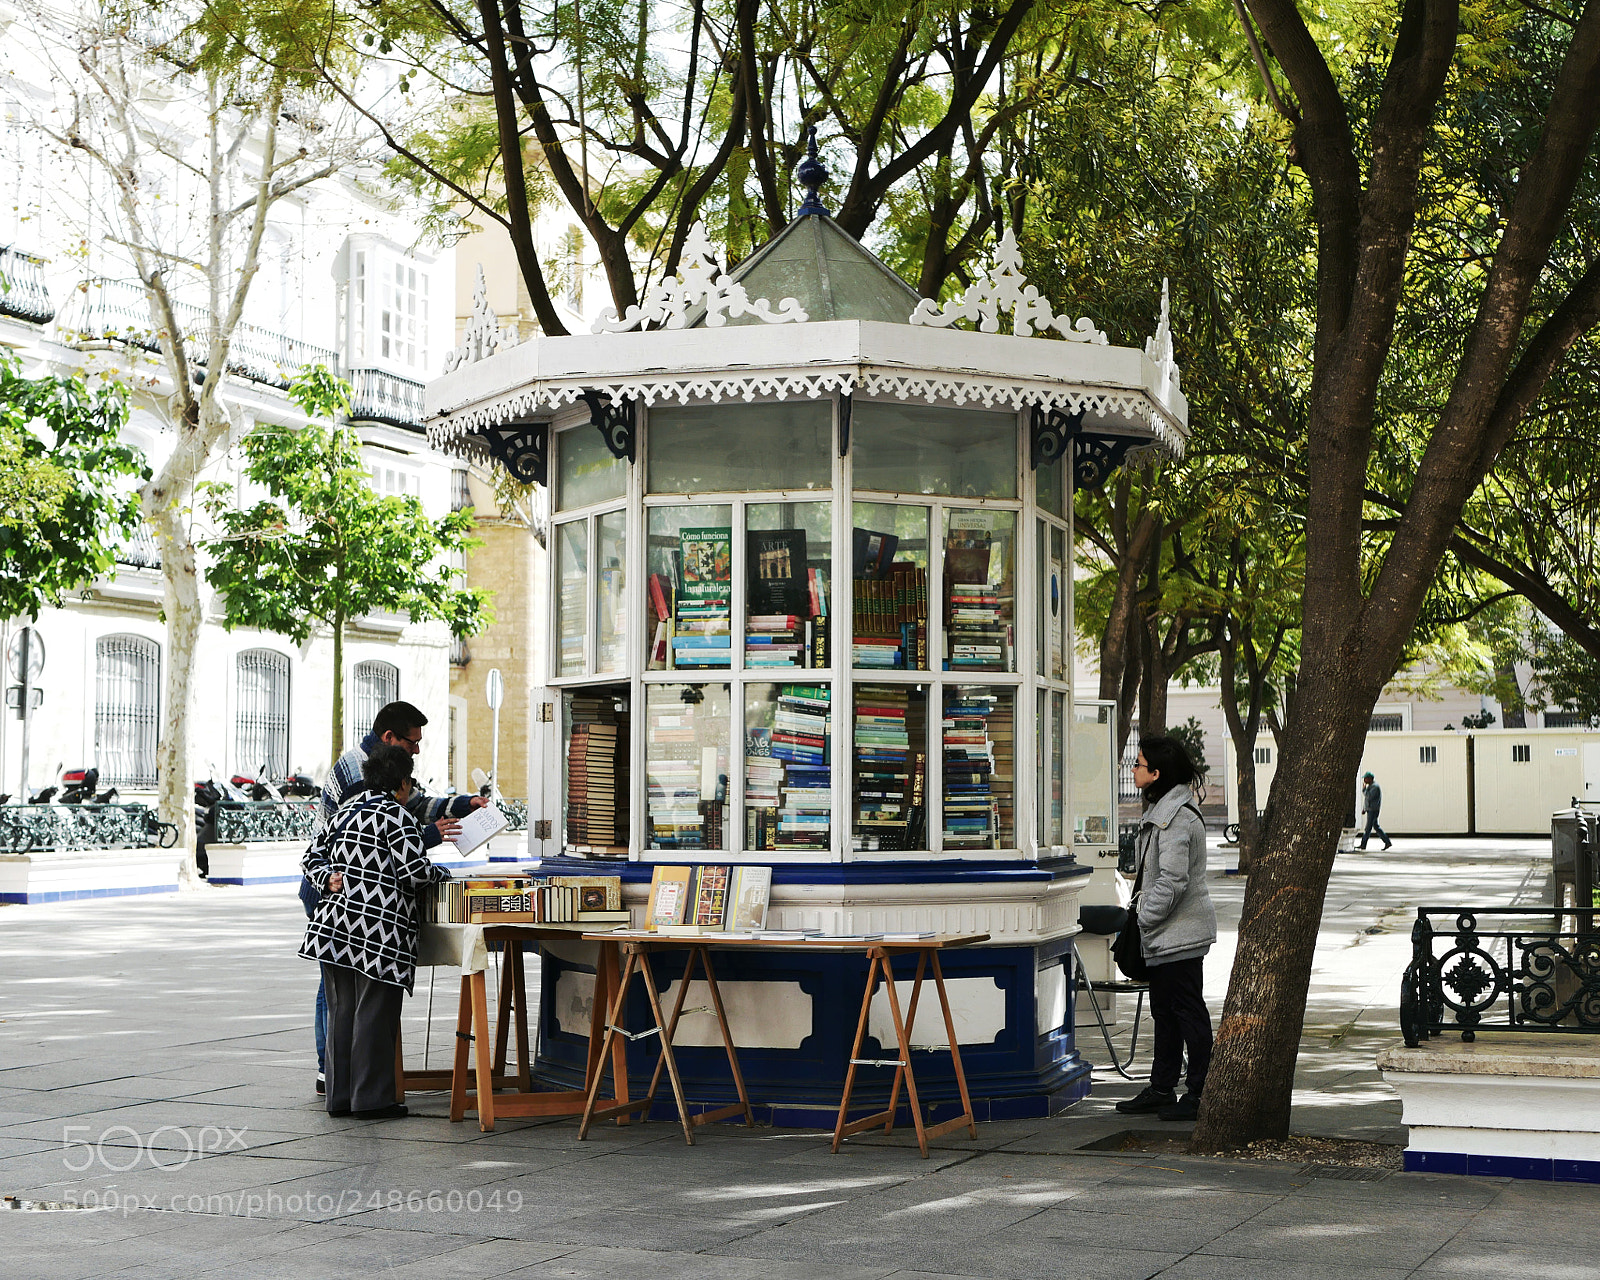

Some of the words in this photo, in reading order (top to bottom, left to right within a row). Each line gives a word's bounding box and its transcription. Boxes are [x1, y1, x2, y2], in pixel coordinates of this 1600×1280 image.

[681, 531, 701, 541] Cómo
[701, 531, 729, 540] funciona
[761, 540, 788, 551] ARTE
[691, 583, 731, 593] naturaleza
